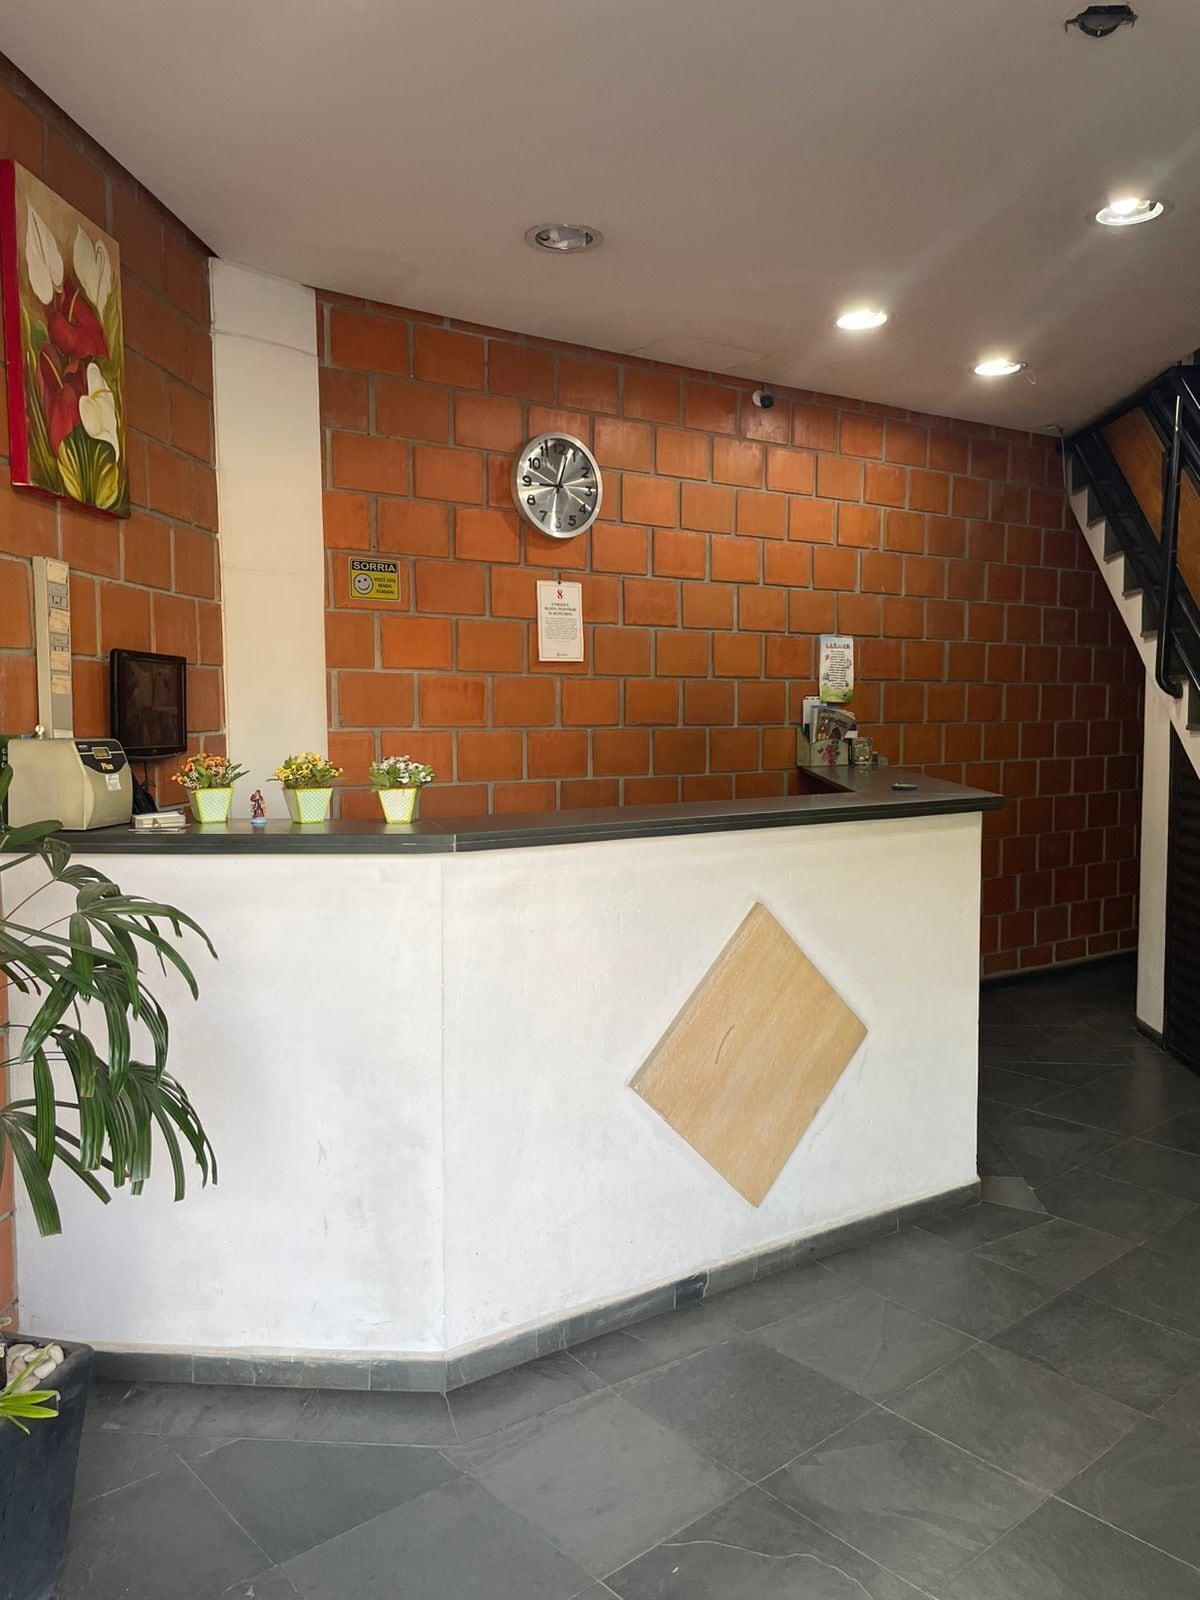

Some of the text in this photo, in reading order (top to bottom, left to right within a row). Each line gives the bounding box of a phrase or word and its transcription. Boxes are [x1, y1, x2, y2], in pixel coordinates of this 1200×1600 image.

[540, 442, 549, 457] 11
[553, 442, 566, 456] 12
[528, 457, 541, 470] 10
[581, 467, 589, 478] 2
[522, 475, 532, 487] 9
[584, 485, 593, 497] 3
[527, 494, 536, 506] 8
[579, 503, 587, 514] 4
[539, 510, 548, 522] 7
[568, 515, 577, 527] 5
[353, 562, 395, 571] SORRIA
[557, 589, 563, 599] 8
